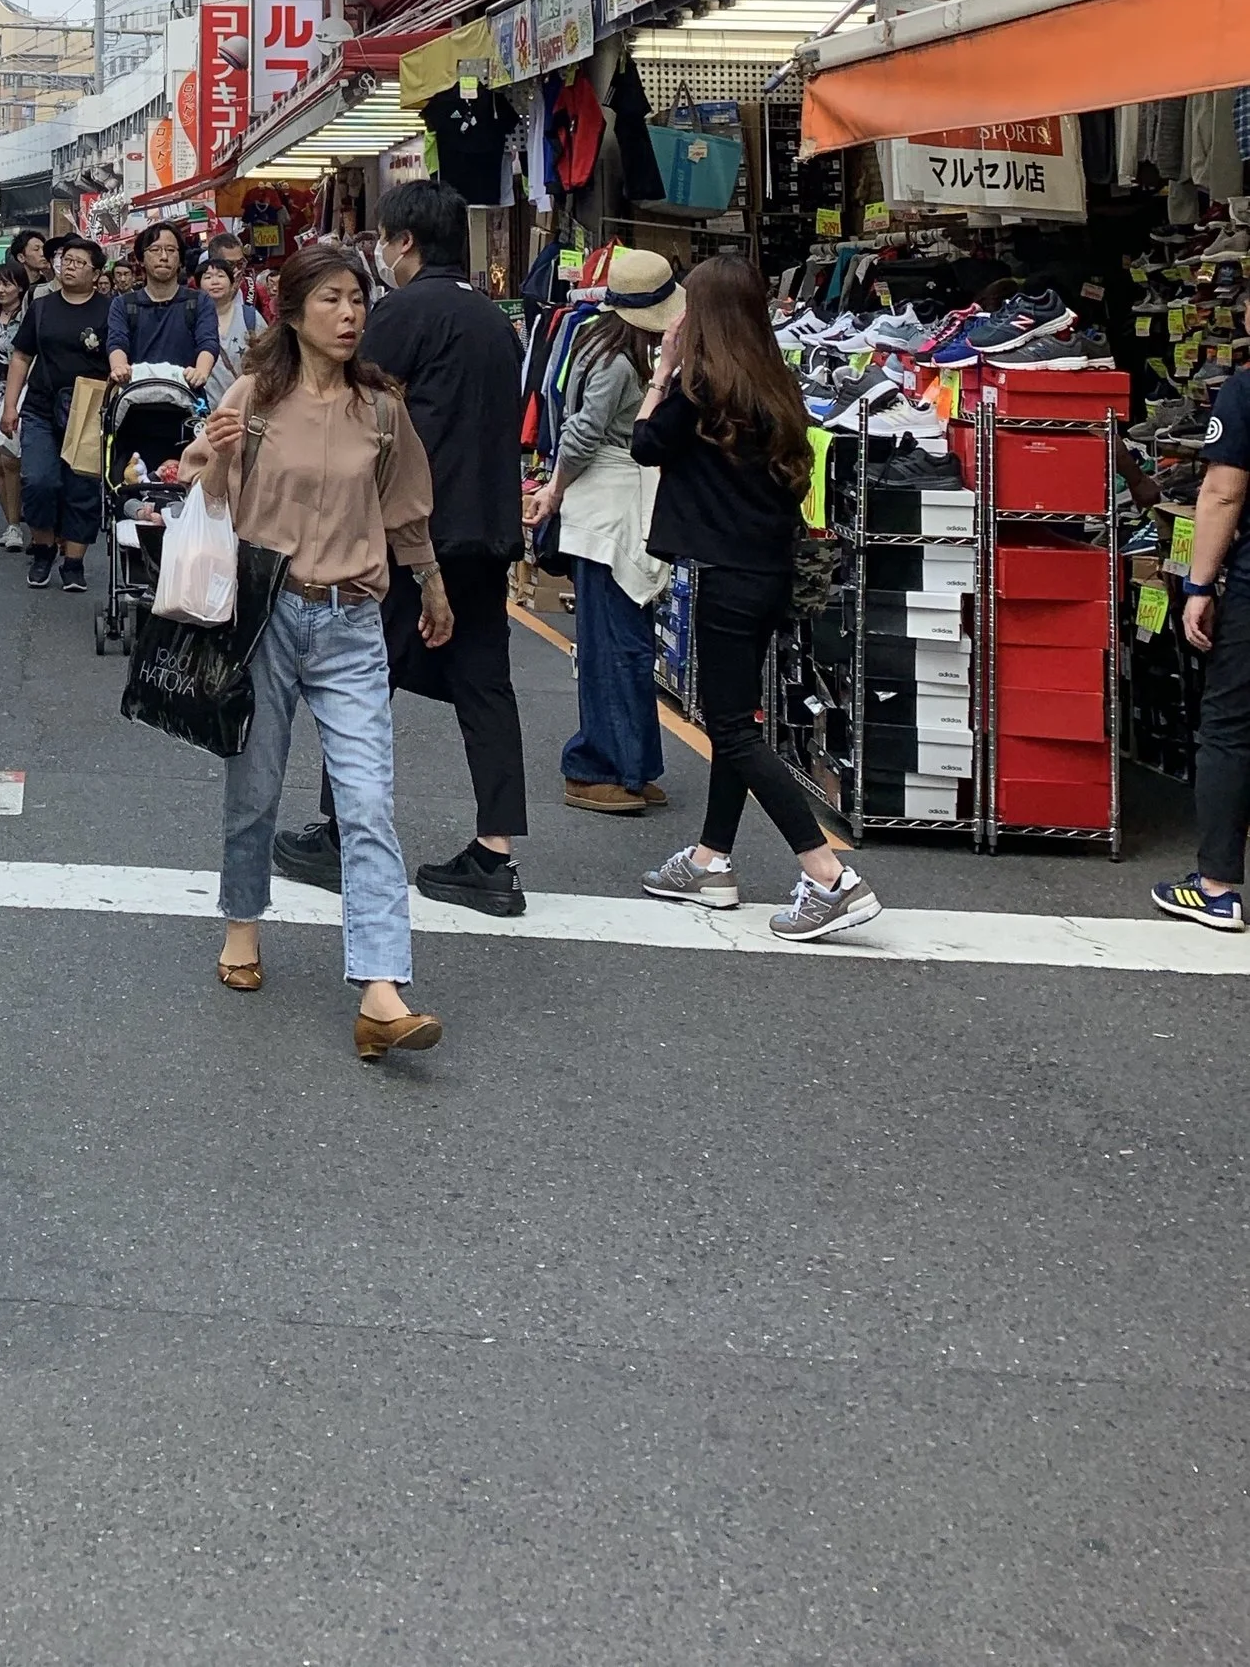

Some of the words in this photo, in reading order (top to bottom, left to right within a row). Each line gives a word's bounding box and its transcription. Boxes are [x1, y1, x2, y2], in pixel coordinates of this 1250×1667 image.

[210, 12, 244, 166] コトブキゴル
[978, 123, 1050, 146] SPORTS
[928, 156, 1046, 195] マルセル店
[946, 524, 968, 532] adidas
[931, 627, 954, 635] adidas
[938, 671, 960, 679] adidas
[138, 662, 196, 697] HATOYA
[940, 716, 962, 724] adidas
[940, 764, 963, 772] adidas
[928, 807, 950, 815] adidas
